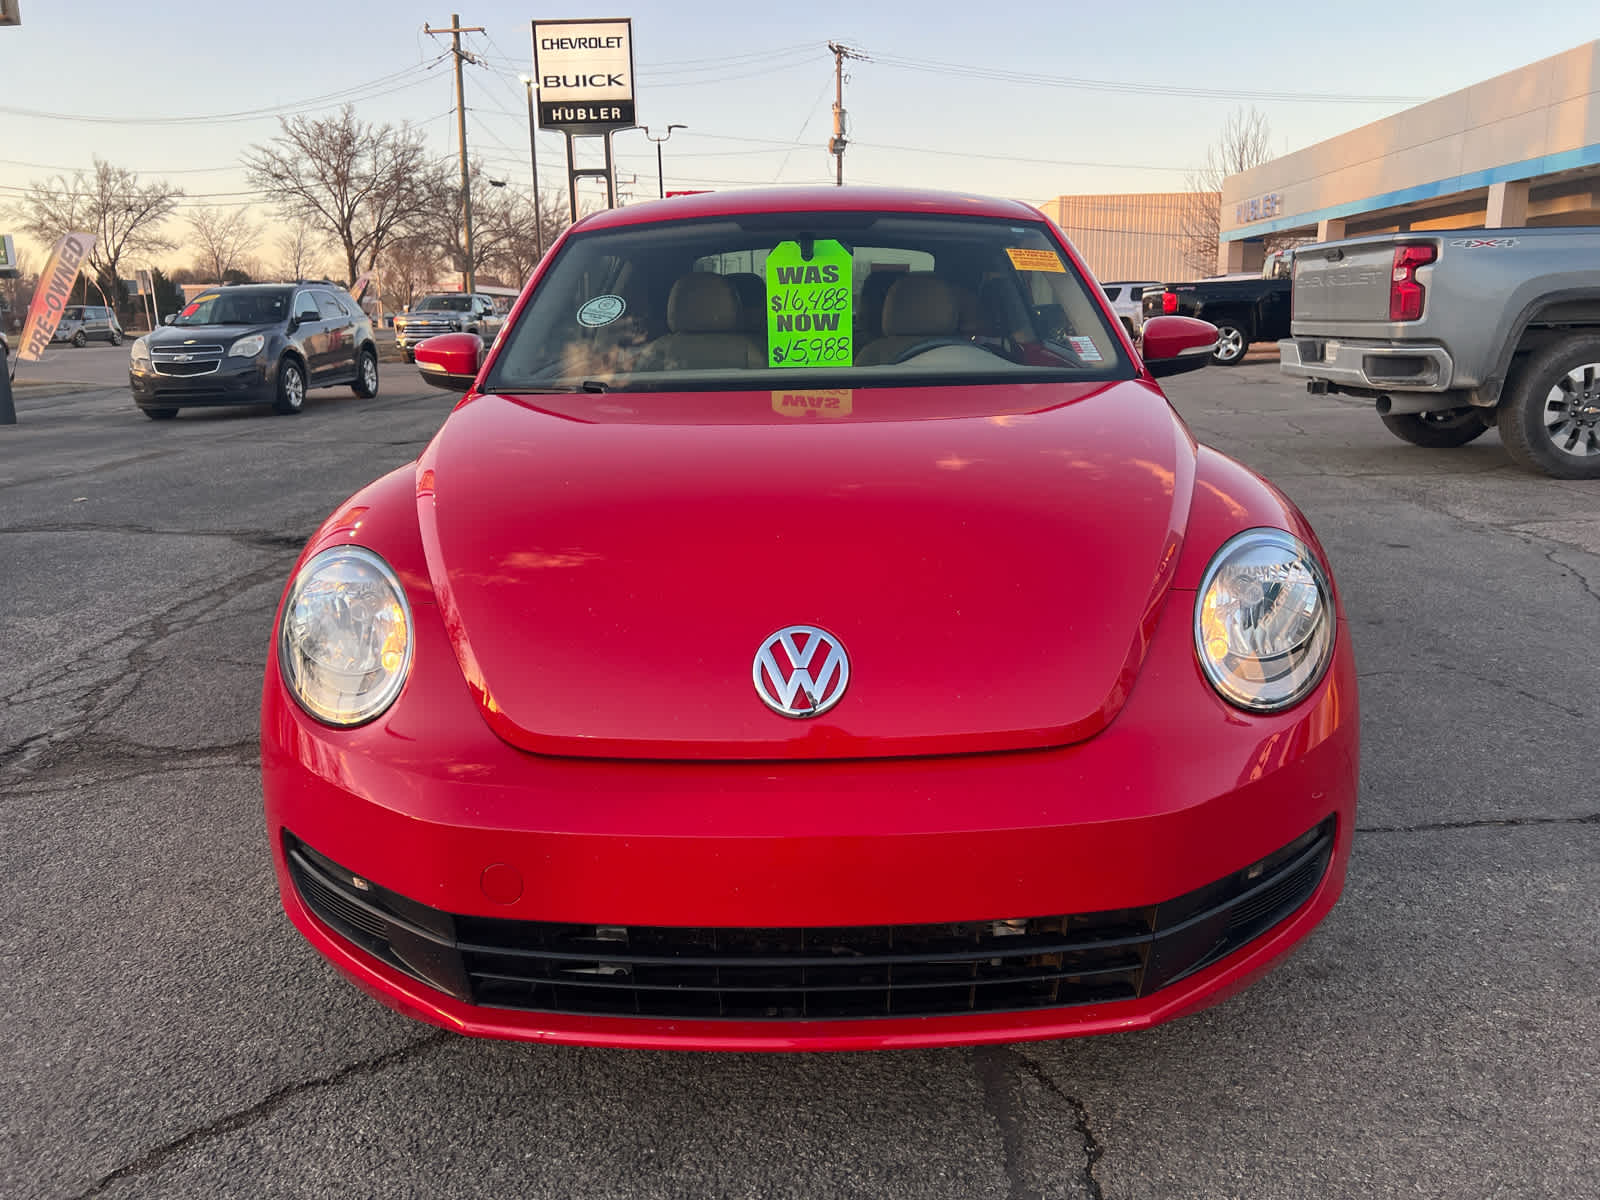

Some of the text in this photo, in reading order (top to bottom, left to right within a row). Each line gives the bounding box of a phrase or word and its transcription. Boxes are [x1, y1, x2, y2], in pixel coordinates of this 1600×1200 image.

[542, 37, 623, 50] CHEVROLET
[544, 74, 625, 87] BUICK
[552, 107, 621, 120] HUBLER
[776, 265, 840, 285] WAS
[28, 236, 84, 361] PRE-OWNED
[771, 288, 849, 313] $16,488
[776, 313, 840, 332] NOW
[772, 337, 850, 364] $15,988
[754, 626, 848, 717] VW
